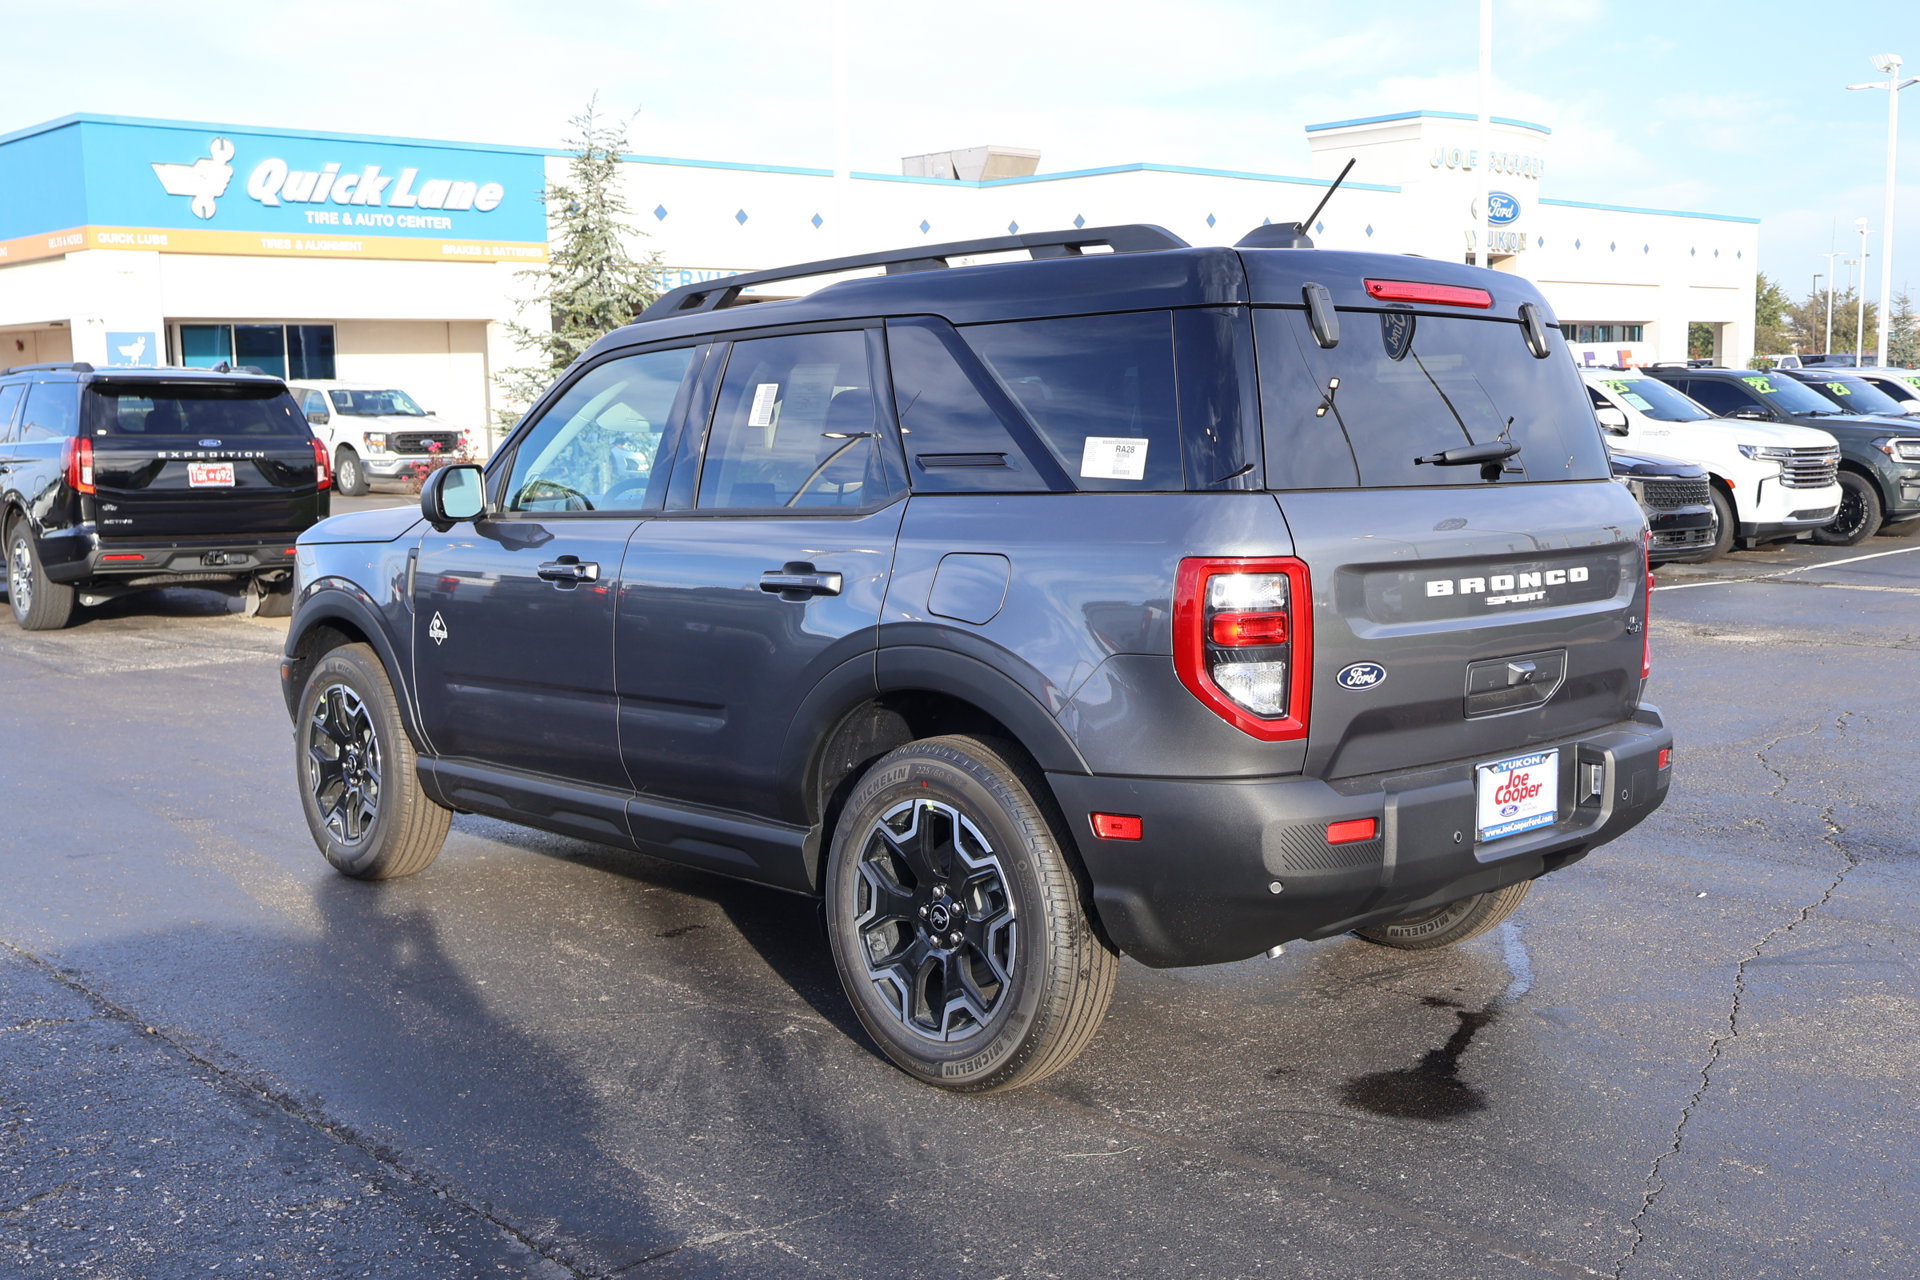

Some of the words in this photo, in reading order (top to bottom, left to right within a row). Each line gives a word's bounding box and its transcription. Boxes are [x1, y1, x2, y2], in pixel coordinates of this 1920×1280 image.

[1432, 147, 1479, 171] JOE
[247, 157, 393, 207] Quick
[388, 167, 505, 212] Lane
[1487, 196, 1515, 219] Ford
[305, 210, 340, 225] TIRE
[342, 211, 353, 225] &
[355, 213, 395, 228] AUTO
[397, 214, 453, 230] CENTER
[97, 232, 135, 245] QUICK
[137, 234, 169, 246] LUBE
[295, 239, 303, 250] &
[482, 245, 491, 256] &
[158, 451, 265, 459] EXPEDITION
[1115, 445, 1136, 454] RA28
[1426, 566, 1589, 598] BRONCO
[1485, 590, 1547, 606] SPORT
[1347, 667, 1378, 686] Ford
[1501, 755, 1541, 771] YUKON
[855, 766, 908, 810] MICHELIN
[1505, 769, 1530, 791] Joe
[1495, 782, 1543, 805] Cooper
[1390, 912, 1450, 938] MICHELIN
[945, 1038, 1005, 1077] MICHELIN
